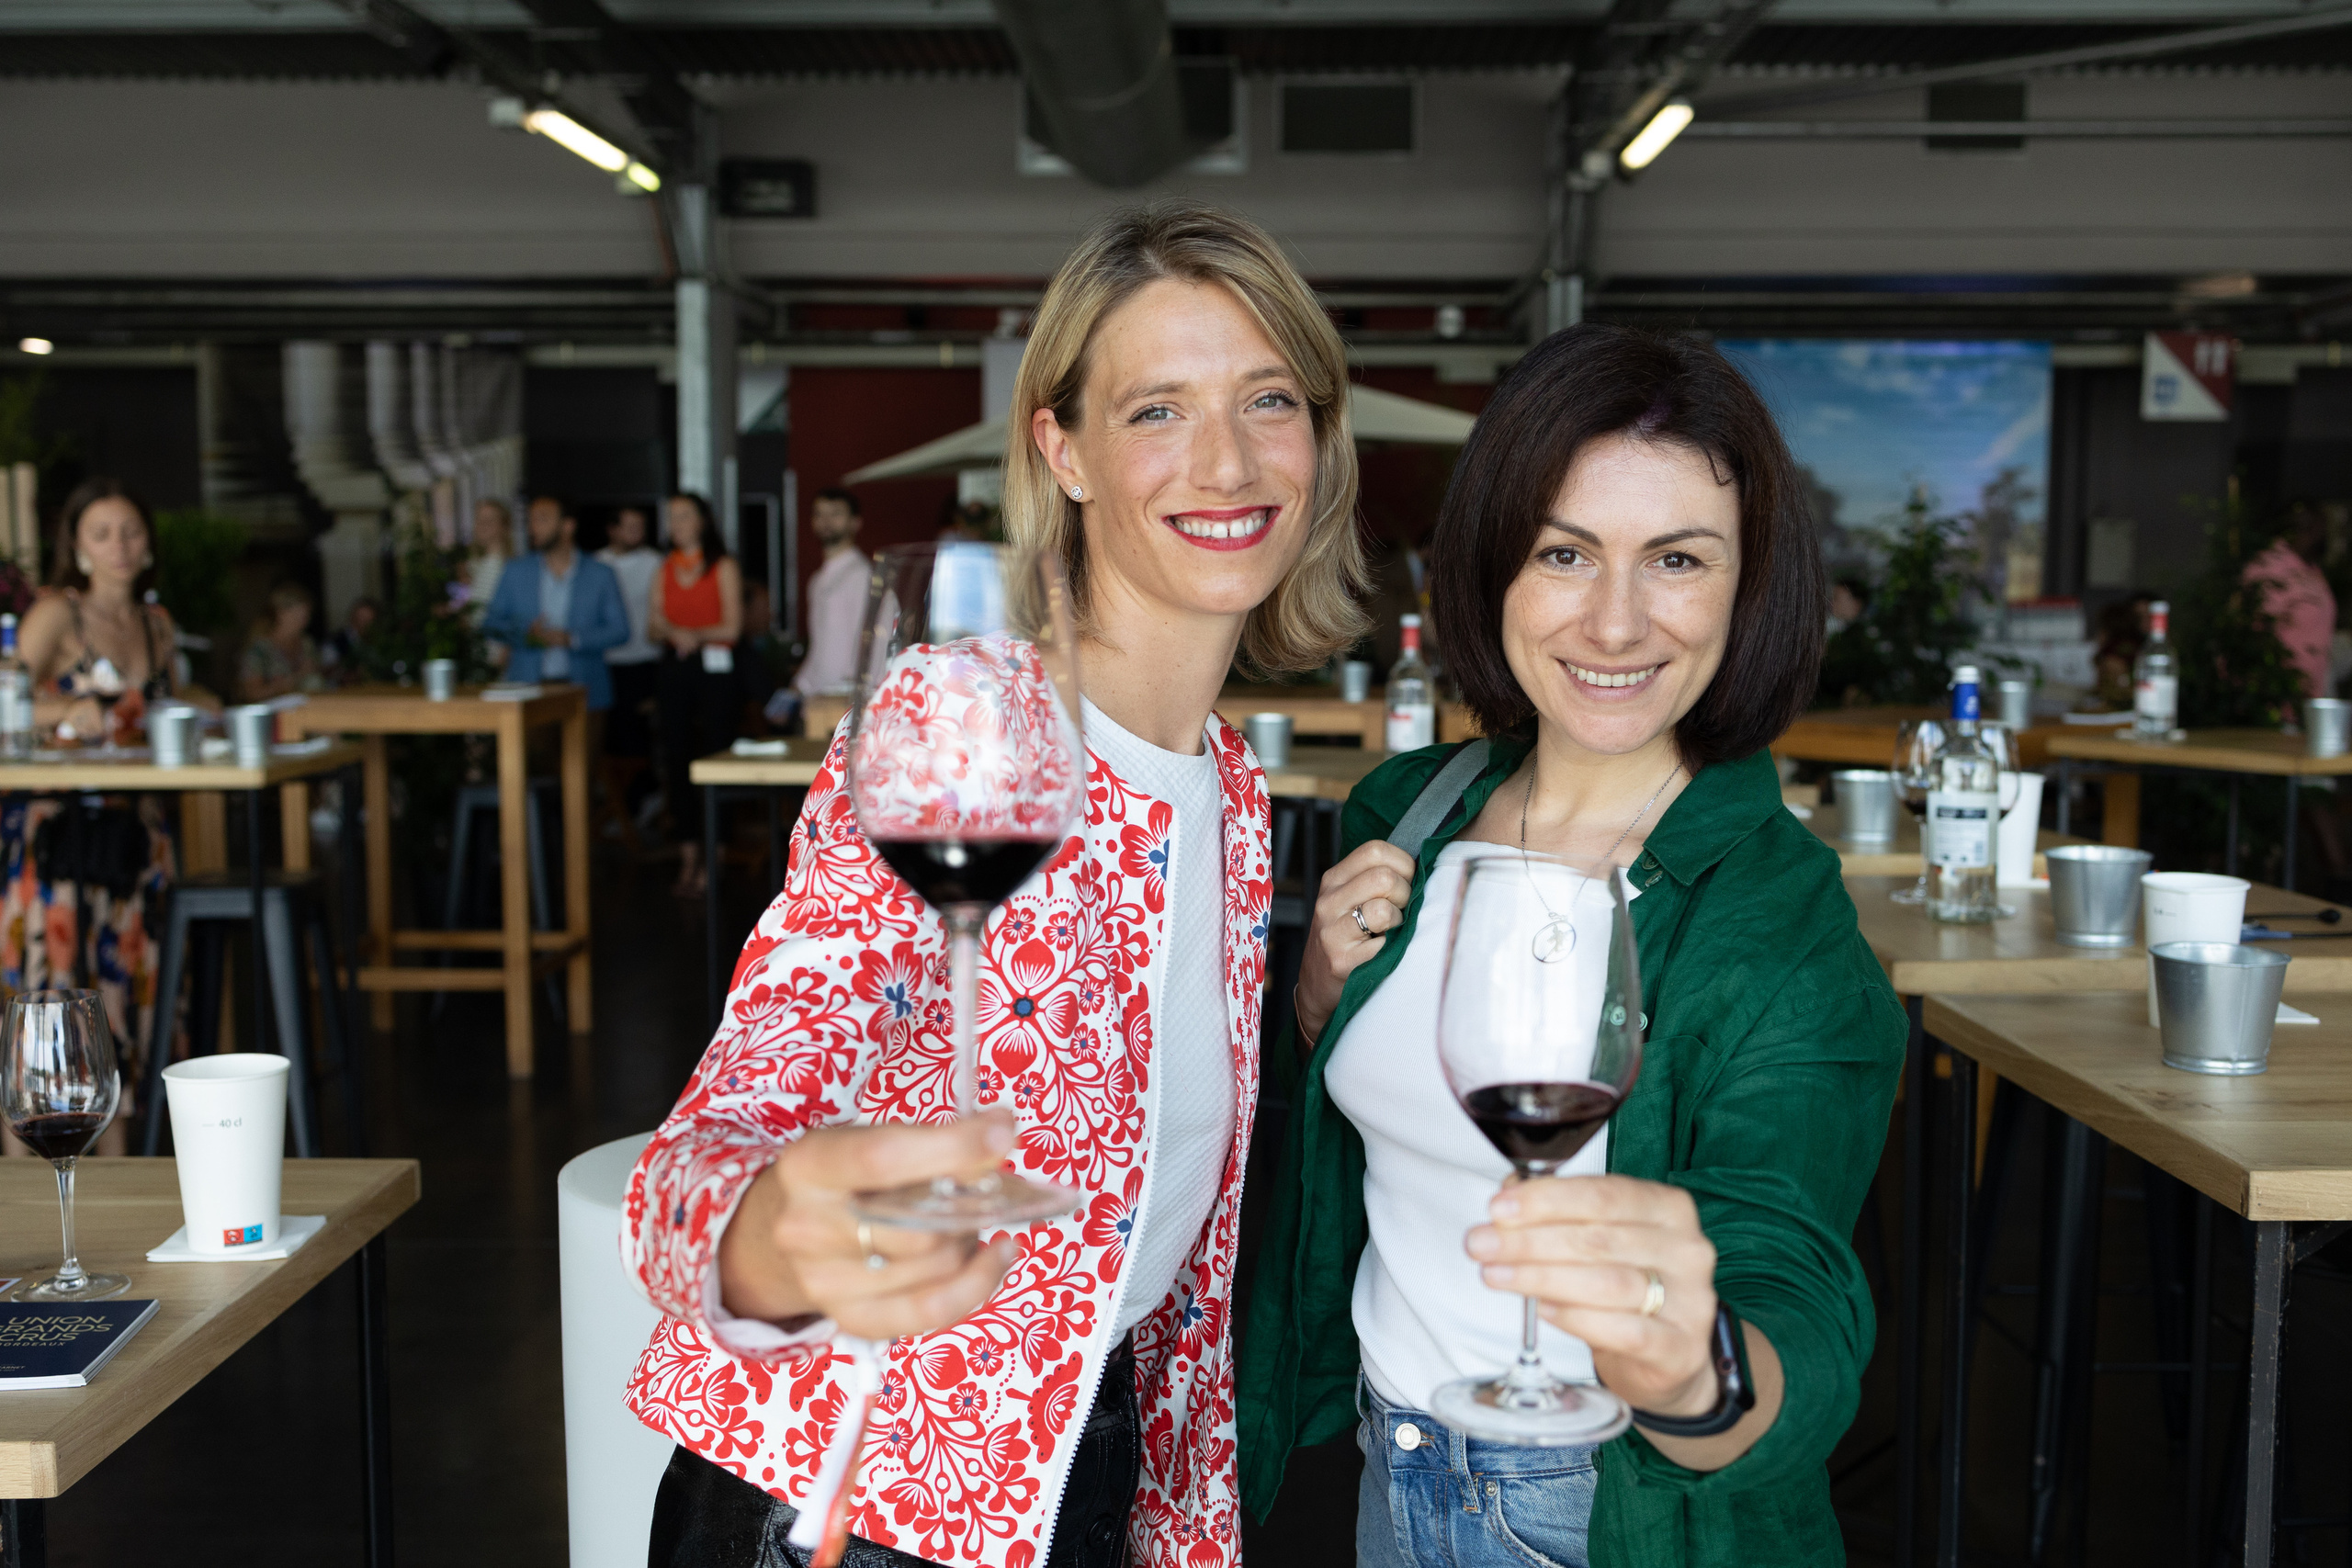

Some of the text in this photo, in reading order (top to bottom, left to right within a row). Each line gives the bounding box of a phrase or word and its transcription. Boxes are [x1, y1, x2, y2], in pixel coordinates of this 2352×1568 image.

[219, 1117, 242, 1128] 40 cl
[8, 1316, 107, 1325] UNION
[0, 1324, 114, 1333] RANDS
[0, 1333, 80, 1342] CRUS
